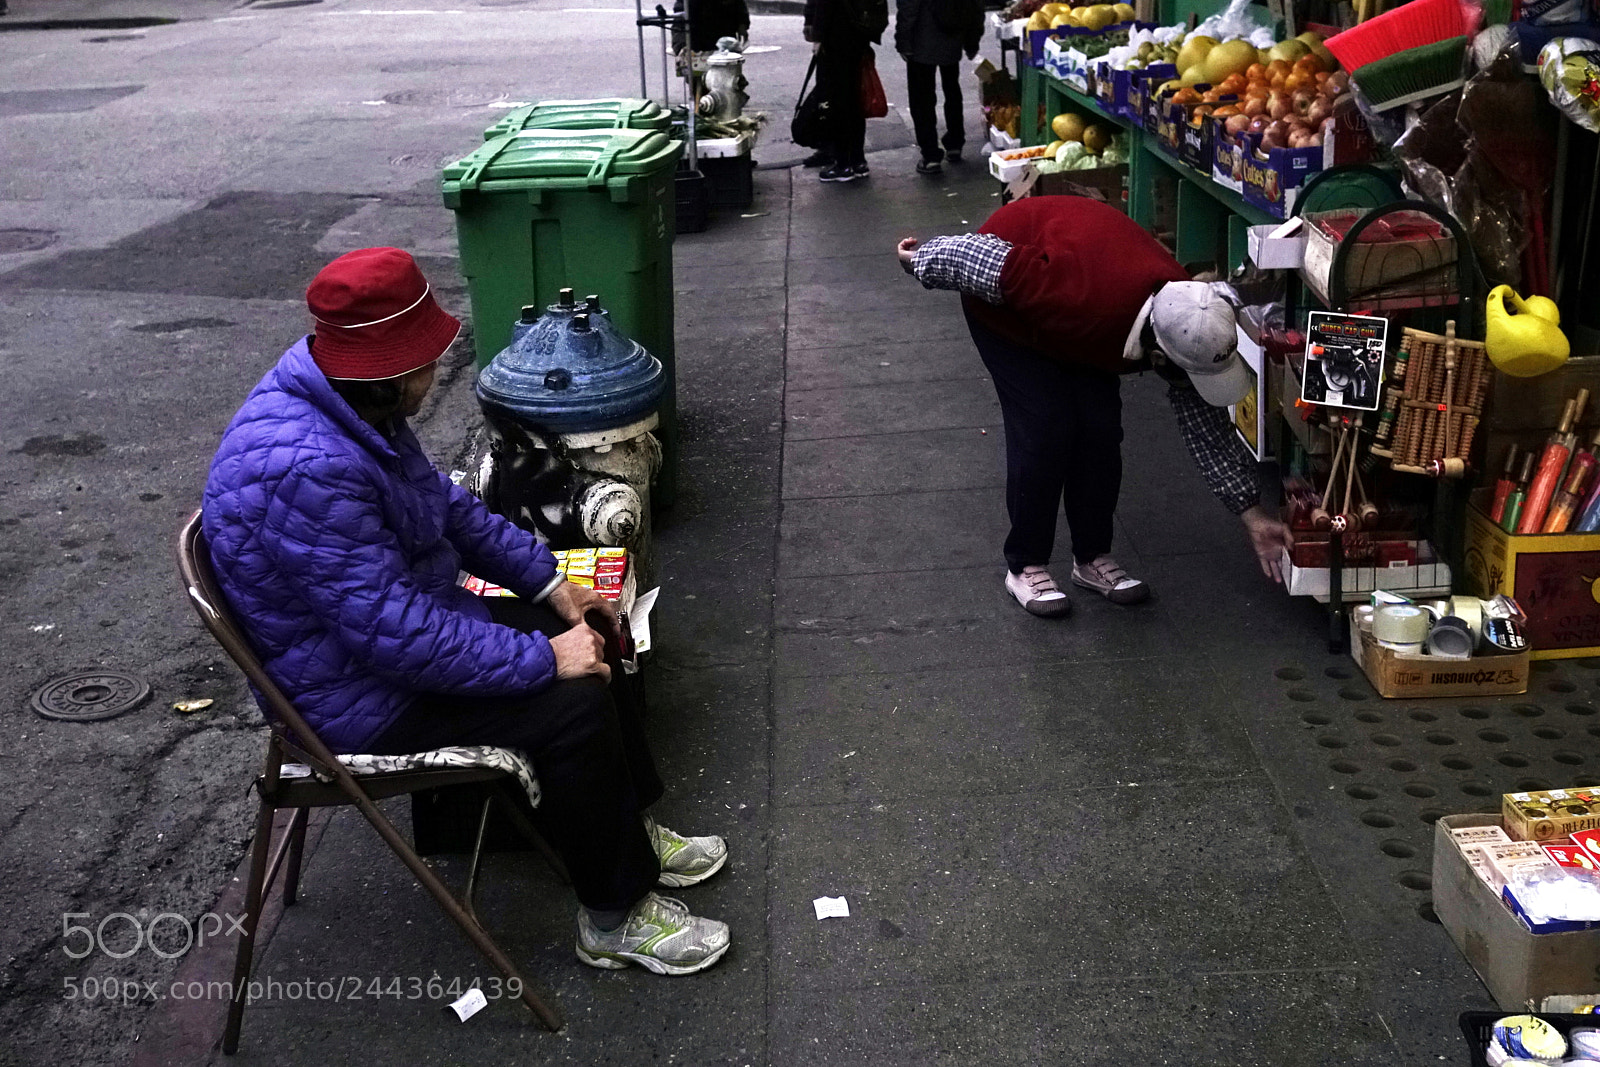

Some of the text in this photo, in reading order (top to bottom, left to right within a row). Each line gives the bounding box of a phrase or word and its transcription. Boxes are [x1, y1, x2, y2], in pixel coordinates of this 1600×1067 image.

[1243, 158, 1265, 188] Cuties
[1320, 323, 1376, 338] SUPER CAP GUN
[1431, 669, 1496, 686] ZOJIRUSHI
